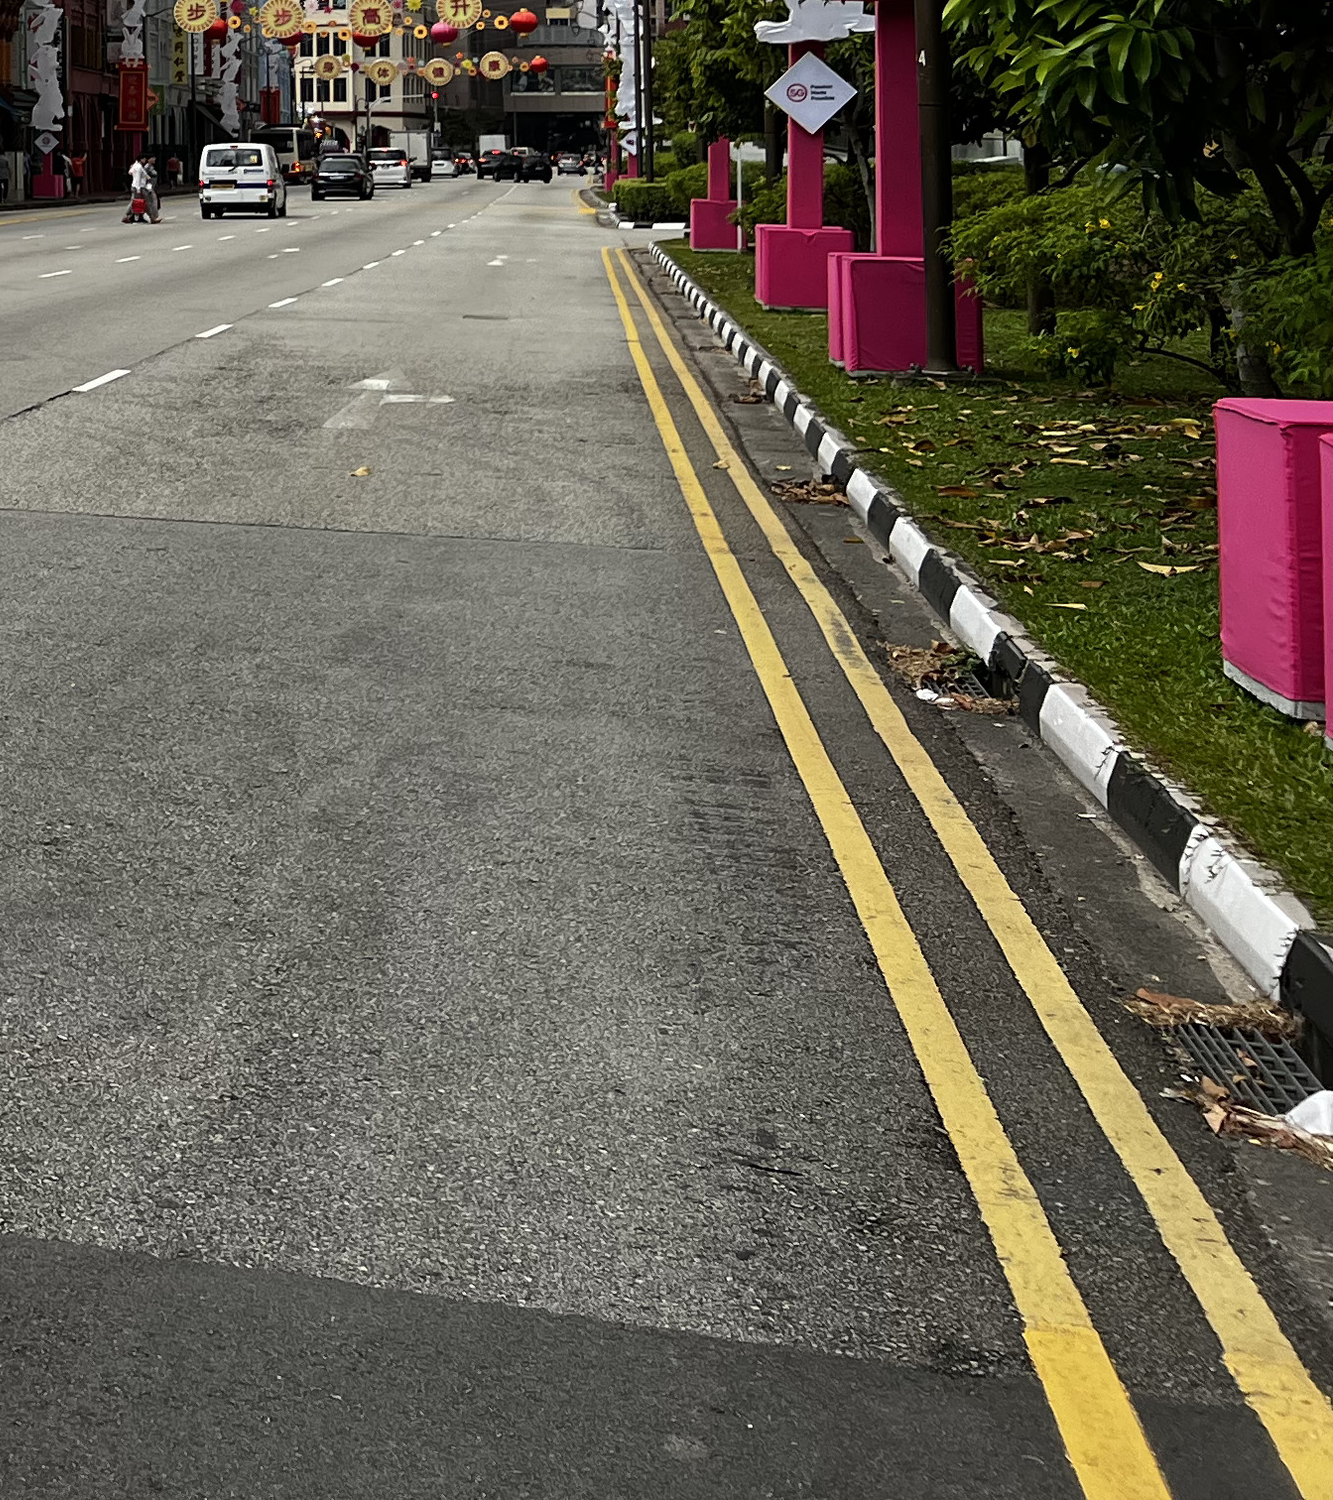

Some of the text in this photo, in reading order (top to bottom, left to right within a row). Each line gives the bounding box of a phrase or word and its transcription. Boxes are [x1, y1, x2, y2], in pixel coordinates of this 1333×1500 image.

[187, 3, 207, 21] 步
[273, 8, 292, 26] 步
[361, 7, 380, 25] 高
[918, 50, 926, 67] 4
[790, 88, 804, 97] SG
